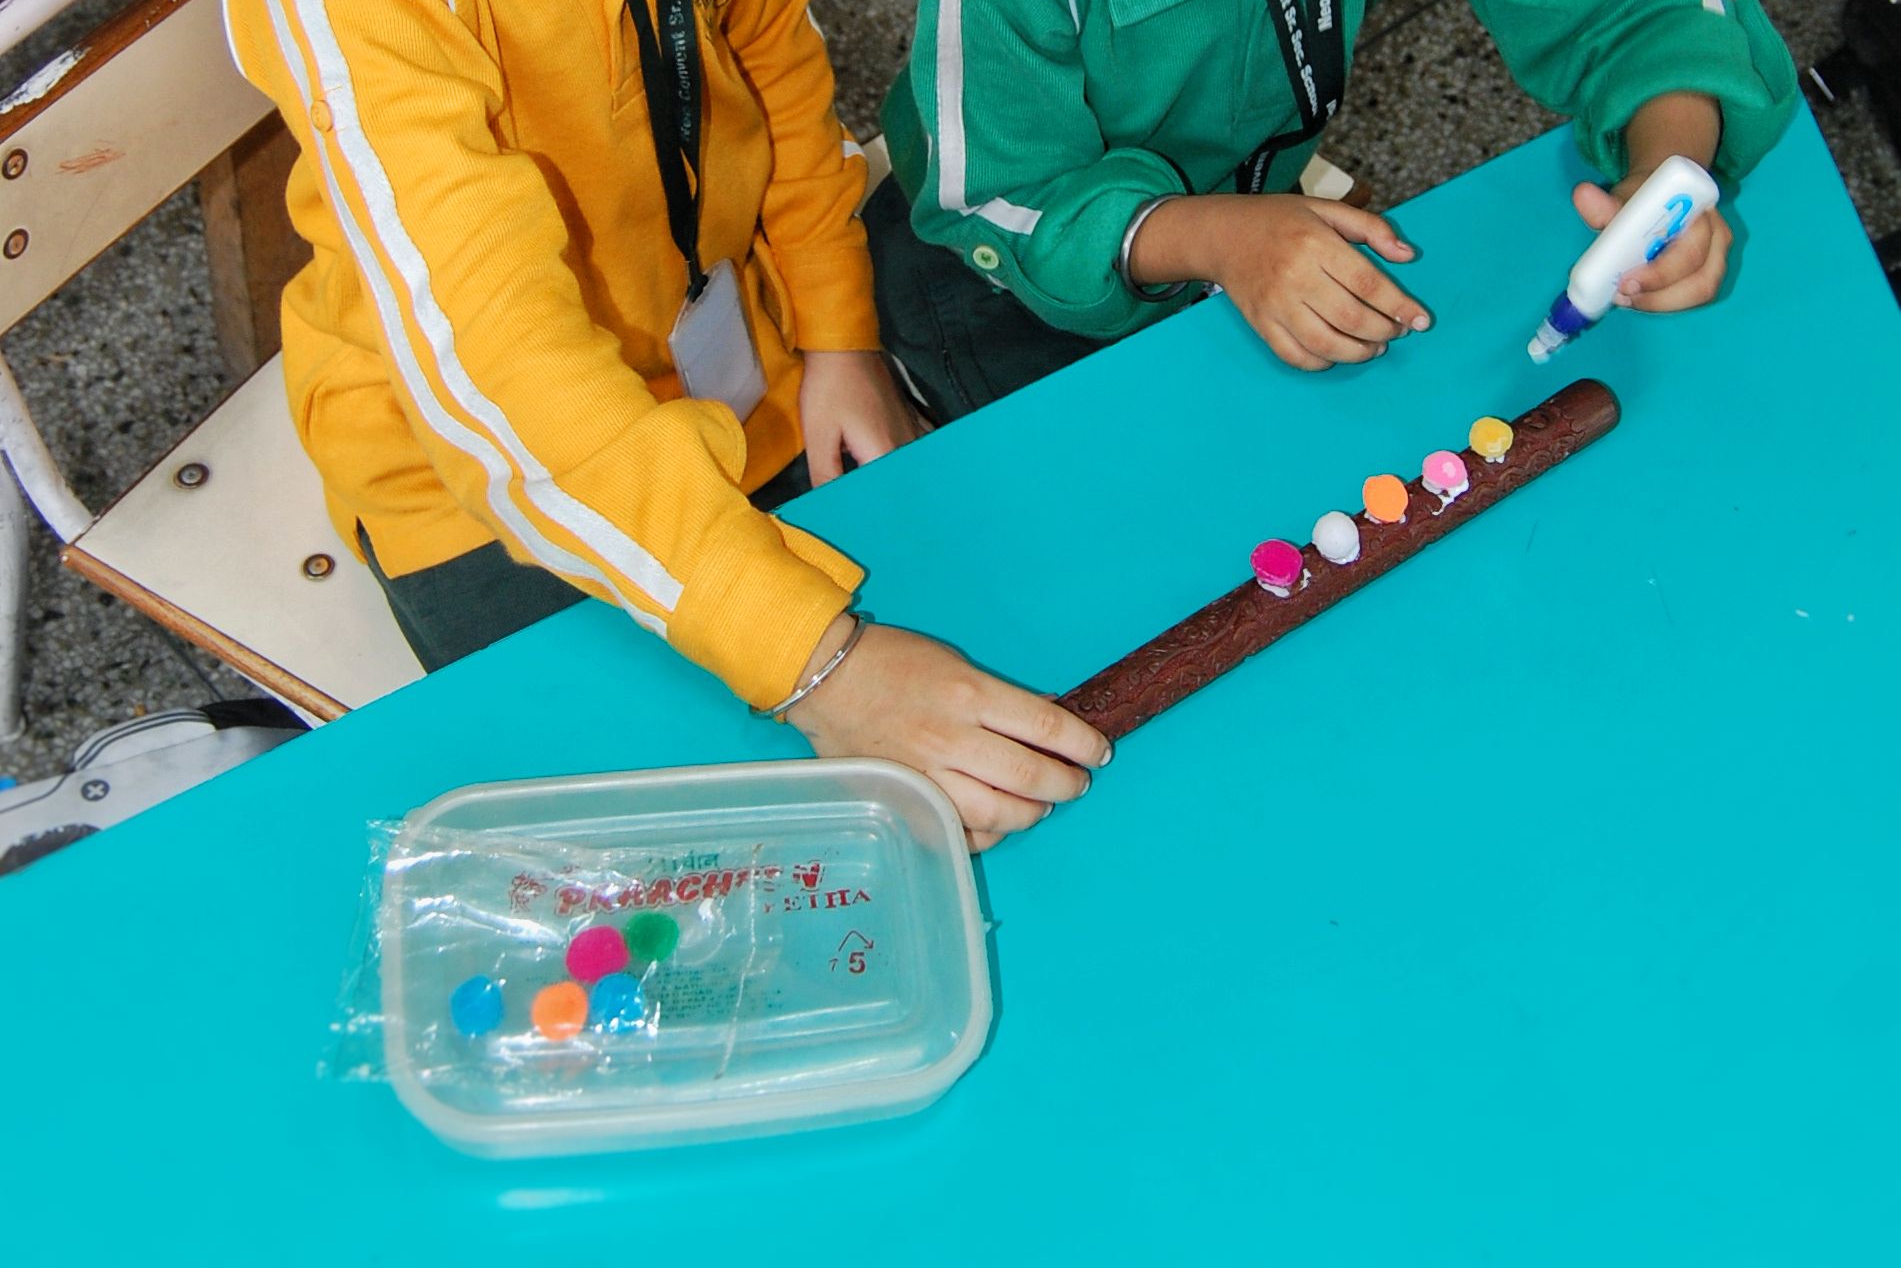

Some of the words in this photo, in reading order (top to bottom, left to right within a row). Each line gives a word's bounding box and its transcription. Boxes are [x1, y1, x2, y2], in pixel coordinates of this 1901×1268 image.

[668, 0, 684, 26] Sr.
[1284, 5, 1297, 34] Sr.
[1291, 29, 1305, 68] Sec.
[670, 30, 691, 101] Convent
[848, 951, 867, 975] 5
